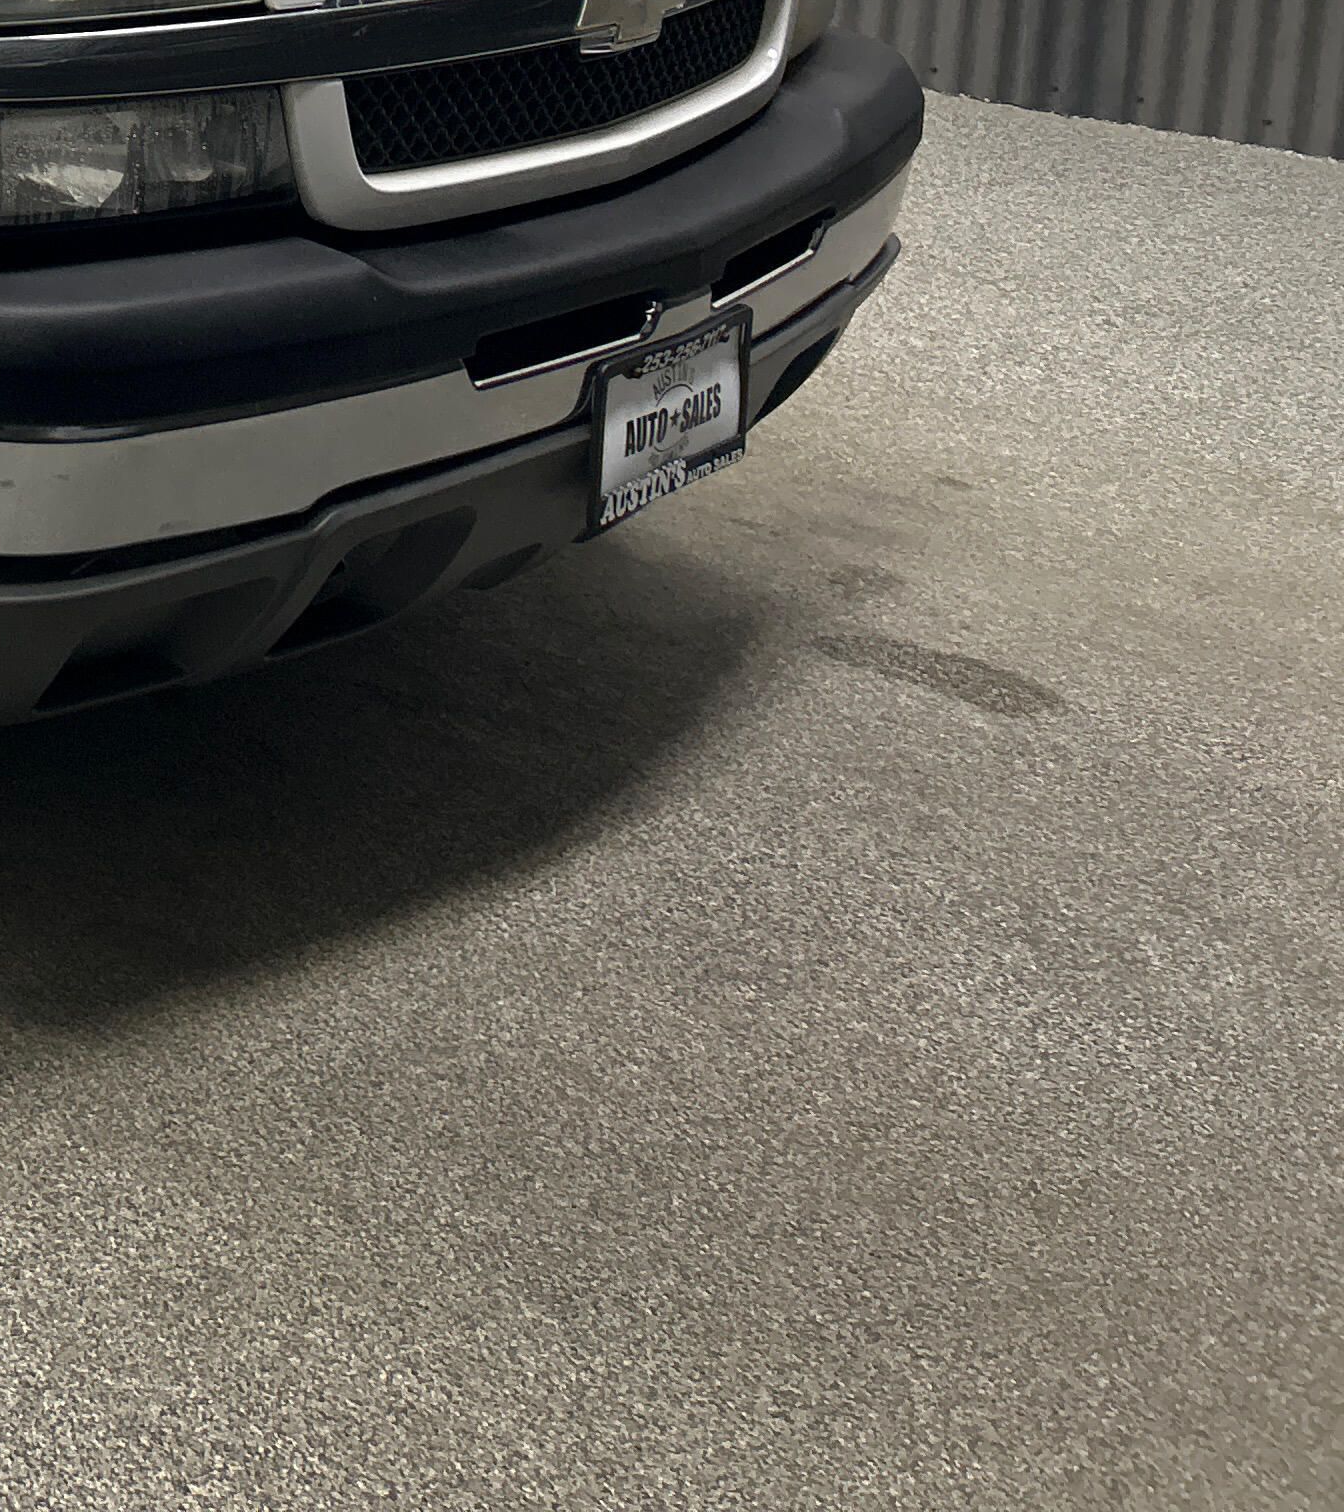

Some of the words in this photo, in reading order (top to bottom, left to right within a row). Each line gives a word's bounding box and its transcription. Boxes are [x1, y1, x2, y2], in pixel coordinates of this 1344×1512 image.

[624, 407, 668, 457] AUTO
[679, 382, 722, 433] SALES
[686, 462, 712, 485] AUTO
[713, 447, 745, 472] SALES
